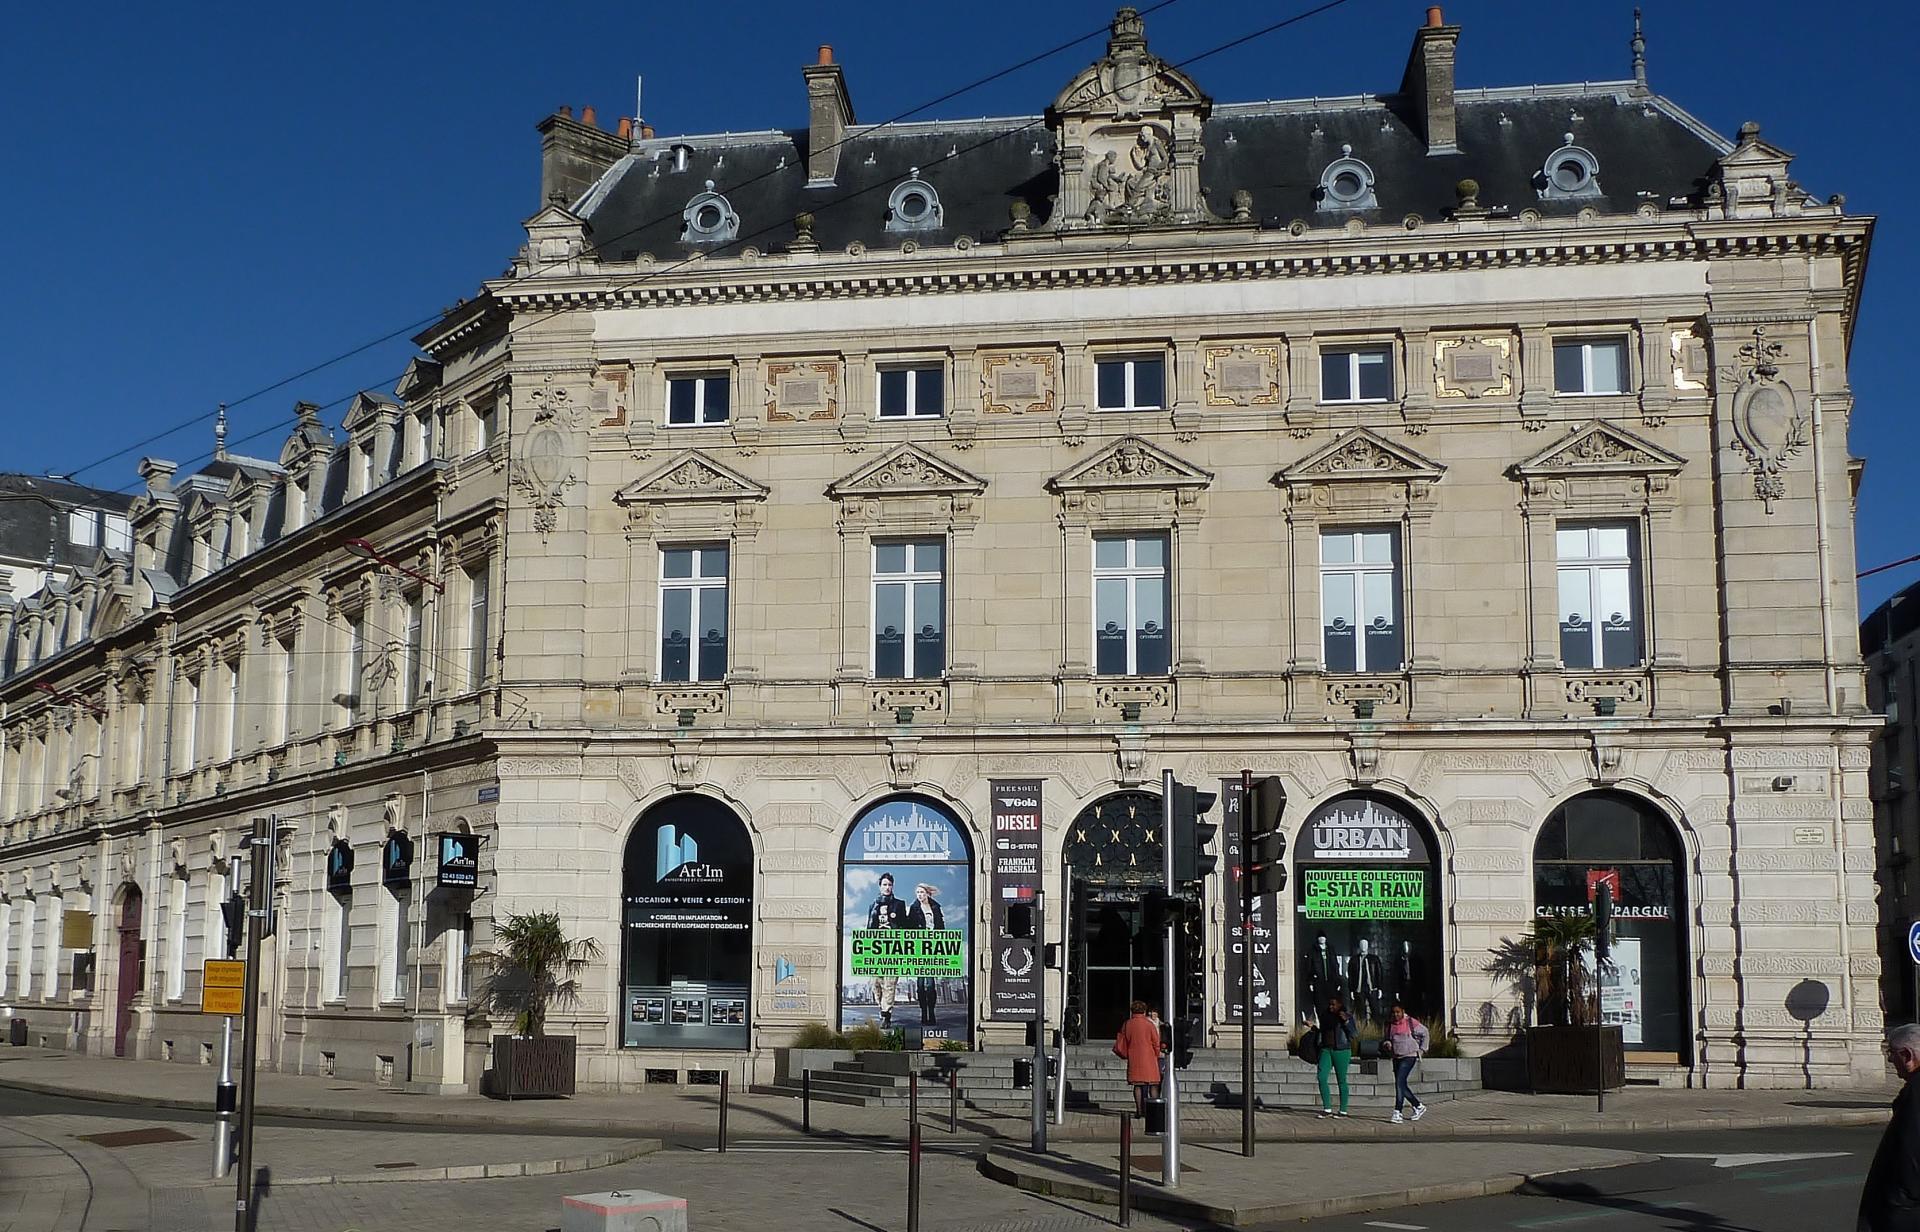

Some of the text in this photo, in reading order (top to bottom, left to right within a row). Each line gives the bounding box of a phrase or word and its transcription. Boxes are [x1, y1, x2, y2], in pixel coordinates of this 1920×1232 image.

[1014, 798, 1038, 807] Gola
[996, 815, 1038, 831] DIESEL
[863, 831, 949, 852] URBAN
[1313, 828, 1408, 849] URBAN
[998, 858, 1036, 866] FRANKLIN
[679, 864, 724, 878] Art'Im
[997, 865, 1037, 874] MARSHALL
[1306, 871, 1423, 882] NOUVELLE COLLECTION
[1306, 881, 1423, 898] G-STAR RAW
[1320, 899, 1410, 908] EN AVANT-PREMIÈRE
[1307, 908, 1423, 919] VENEZ VITE LA DÉCOUVRIR
[852, 930, 962, 940] NOUVELLE COLLECTION
[852, 940, 961, 956] G-STAR RAW
[1232, 943, 1271, 954] OLY.
[864, 956, 950, 966] EN AVANT-PREMIÈRE
[852, 966, 961, 977] VENEZ VITE LA DÉCOUVRIR
